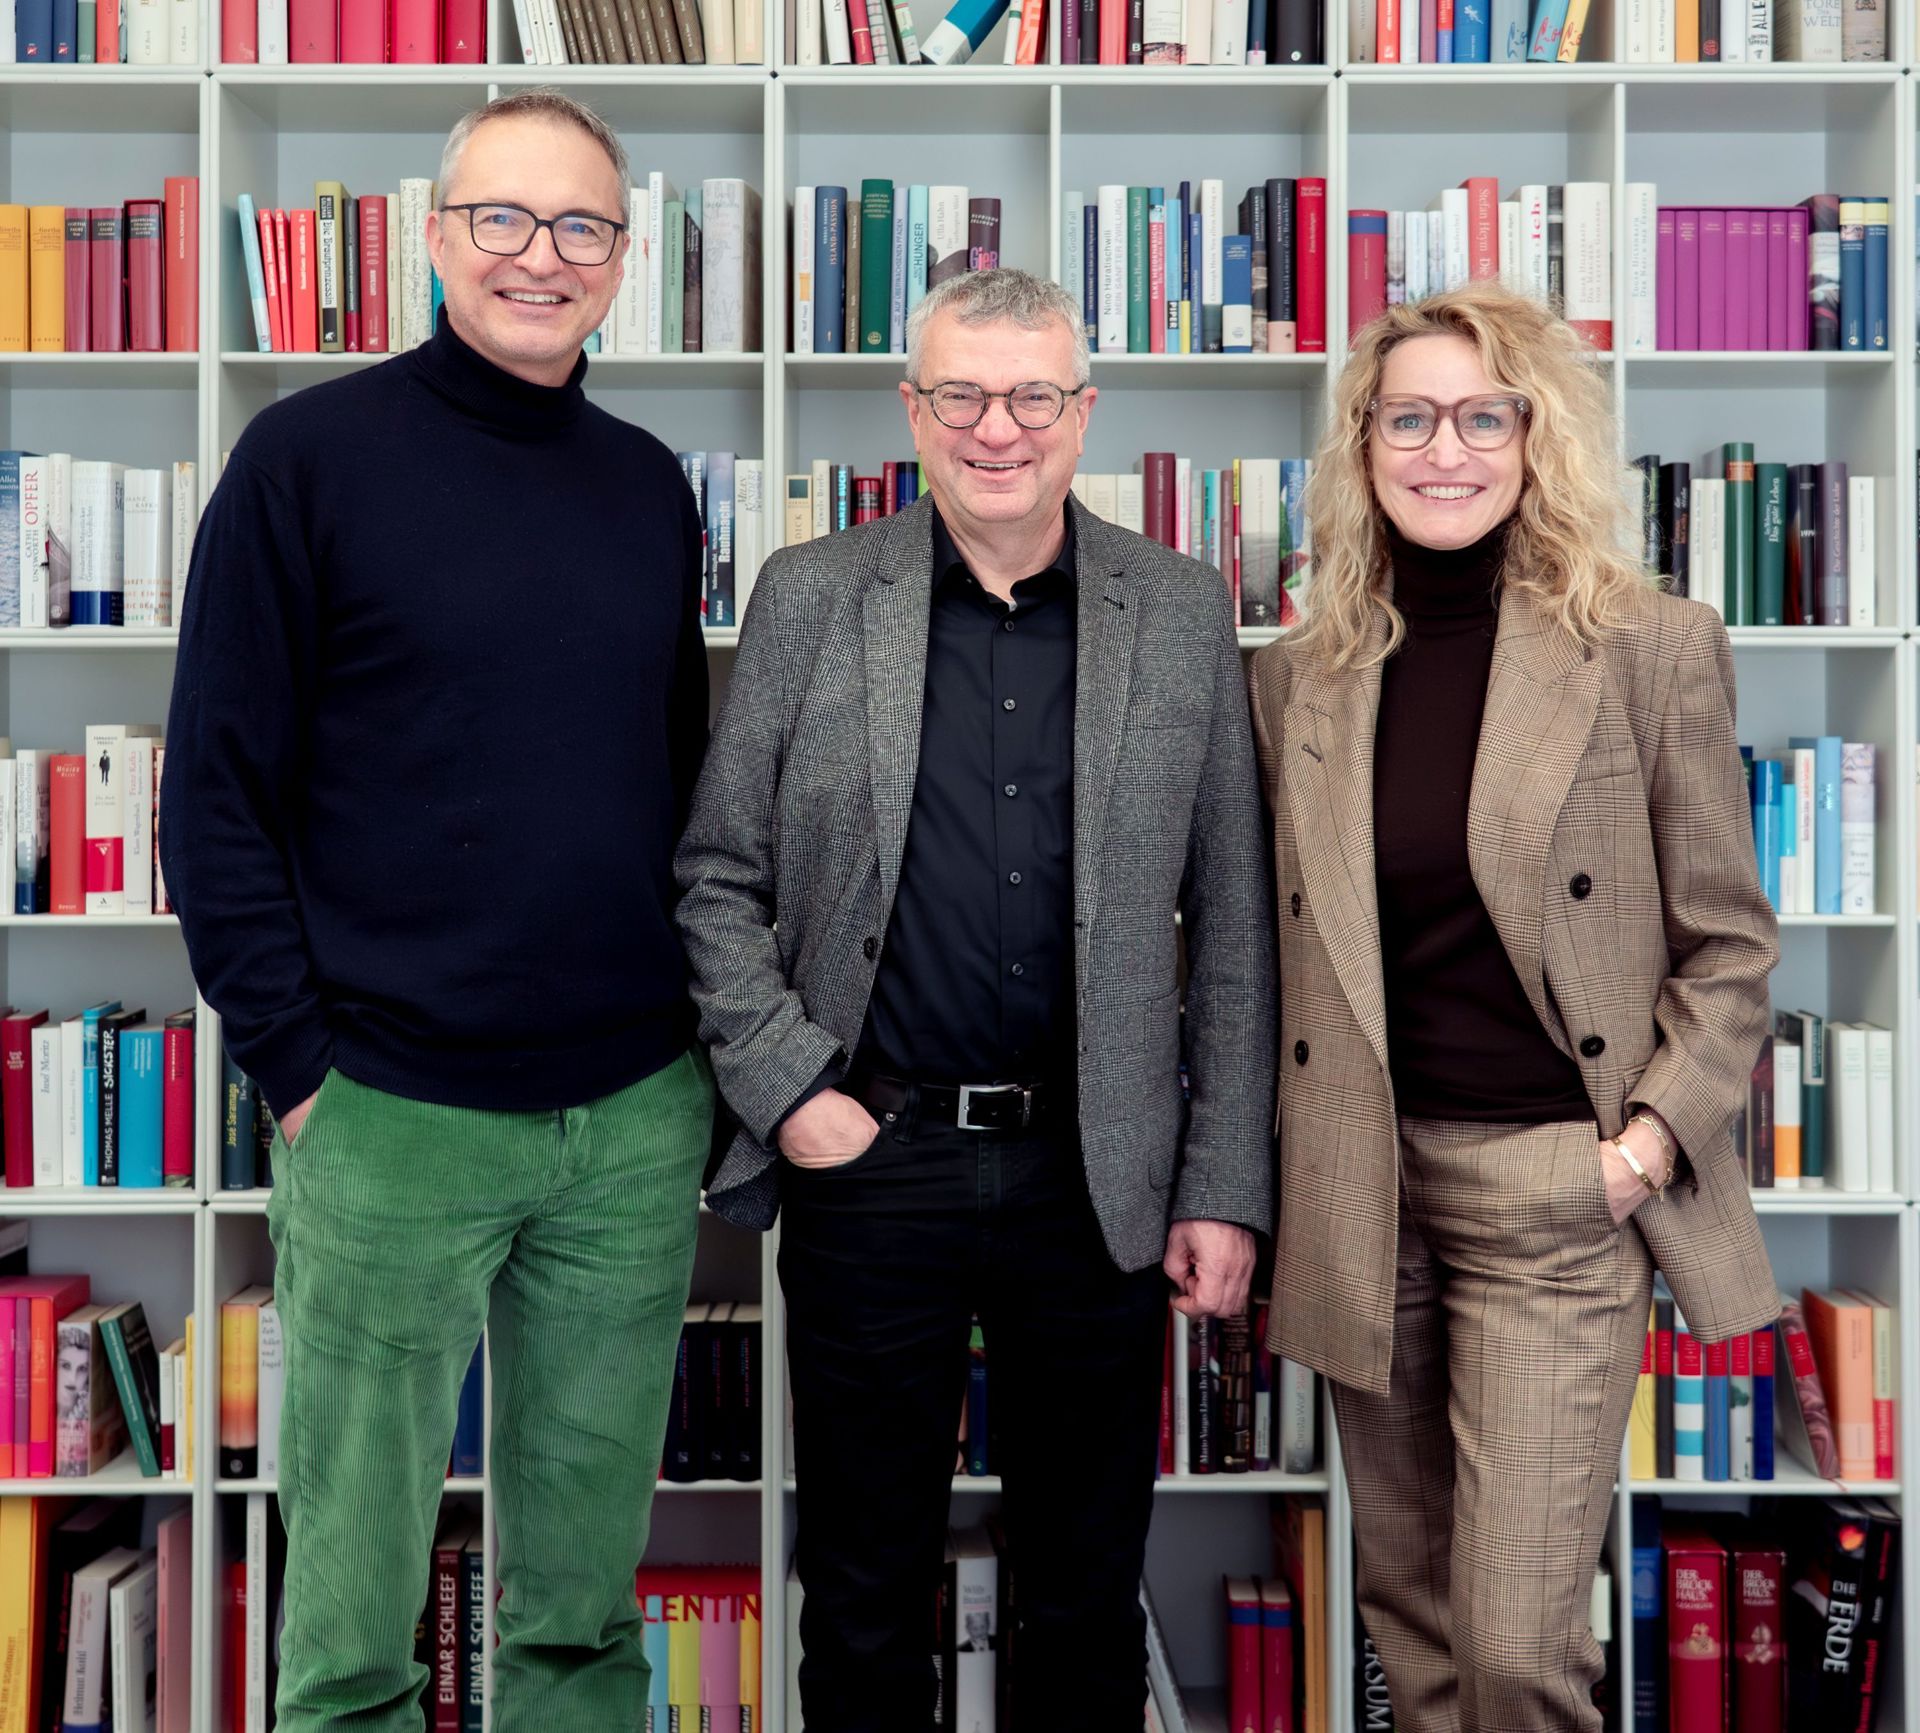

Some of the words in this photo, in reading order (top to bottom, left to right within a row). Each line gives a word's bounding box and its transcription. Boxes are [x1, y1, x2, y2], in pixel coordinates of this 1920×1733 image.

[1803, 16, 1840, 27] WELT
[936, 201, 945, 222] Hahn
[1135, 197, 1143, 216] Wand
[1479, 188, 1490, 218] Stefan
[323, 222, 333, 236] Die
[895, 218, 903, 243] PFADEN
[1068, 211, 1077, 225] Fall
[1115, 199, 1123, 243] ZWILLING
[914, 223, 924, 266] HUNGER
[936, 225, 945, 240] Ulla
[1068, 226, 1077, 253] Große
[1477, 222, 1490, 251] Heym
[321, 238, 334, 306] Brautprinzessin
[1068, 256, 1077, 268] Der
[1103, 229, 1112, 290] Haratischwili
[1115, 246, 1123, 288] SANFTER
[1479, 258, 1490, 275] Die
[1103, 294, 1112, 315] Nino
[1115, 291, 1123, 315] MEIN
[1168, 301, 1177, 328] PIPER
[838, 470, 847, 497] BUCH
[1769, 477, 1779, 504] Leben
[1833, 481, 1841, 502] Liebe
[25, 470, 38, 525] OPFER
[1833, 503, 1841, 516] der
[1771, 506, 1781, 524] gute
[718, 500, 731, 562] Rauhnacht
[1769, 526, 1779, 542] Das
[1833, 517, 1841, 557] Geschichte
[32, 529, 40, 582] UNSWORTH
[40, 1040, 50, 1070] Moritz
[103, 1028, 114, 1089] SICKSTER
[105, 1094, 113, 1126] MELLE
[227, 1084, 239, 1126] Saramago
[105, 1128, 113, 1170] THOMAS
[226, 1127, 237, 1147] José
[1200, 1375, 1209, 1388] Der
[1200, 1391, 1209, 1412] Llosa
[1295, 1392, 1305, 1416] Wolf
[1200, 1413, 1209, 1438] Vargas
[1295, 1416, 1305, 1450] Christa
[1200, 1440, 1209, 1463] Mario
[1676, 1569, 1699, 1579] DER
[1743, 1569, 1765, 1579] DER
[1676, 1589, 1709, 1600] HAUS
[1832, 1580, 1857, 1596] DIE
[439, 1573, 455, 1645] SCHLEEF
[643, 1594, 762, 1623] LENTIN
[1823, 1599, 1856, 1674] ERDE
[76, 1650, 87, 1674] Kohl
[1861, 1640, 1879, 1693] Bernhard
[439, 1649, 455, 1704] EINAR
[1364, 1637, 1392, 1730] KSUM
[72, 1677, 86, 1716] Helmut
